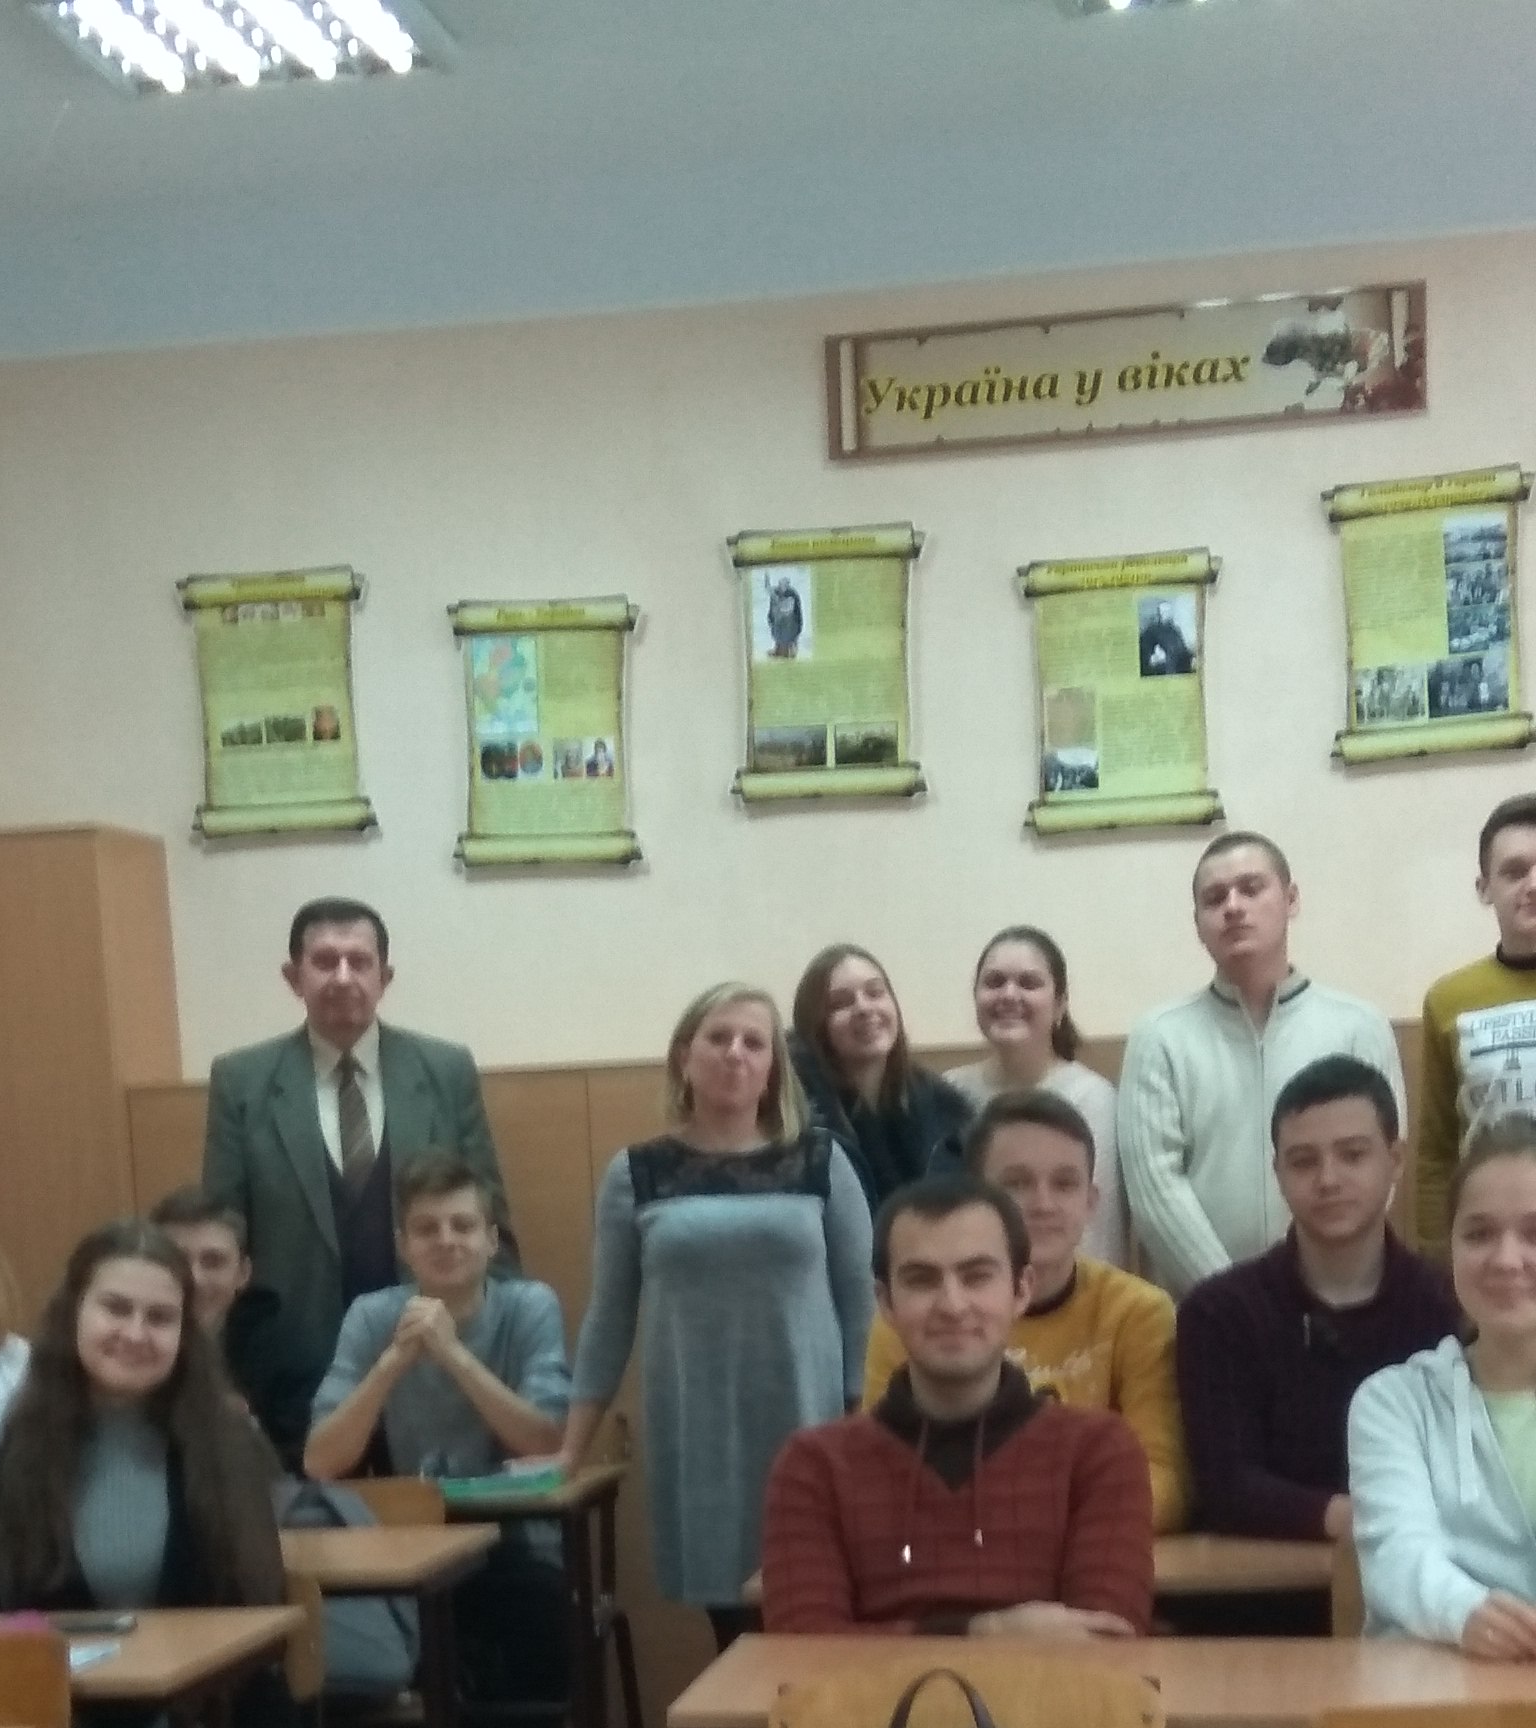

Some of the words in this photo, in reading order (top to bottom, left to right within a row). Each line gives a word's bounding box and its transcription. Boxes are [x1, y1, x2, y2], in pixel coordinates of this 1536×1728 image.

[864, 364, 1060, 420] Україна
[1075, 368, 1104, 406] у
[1117, 350, 1251, 393] віках
